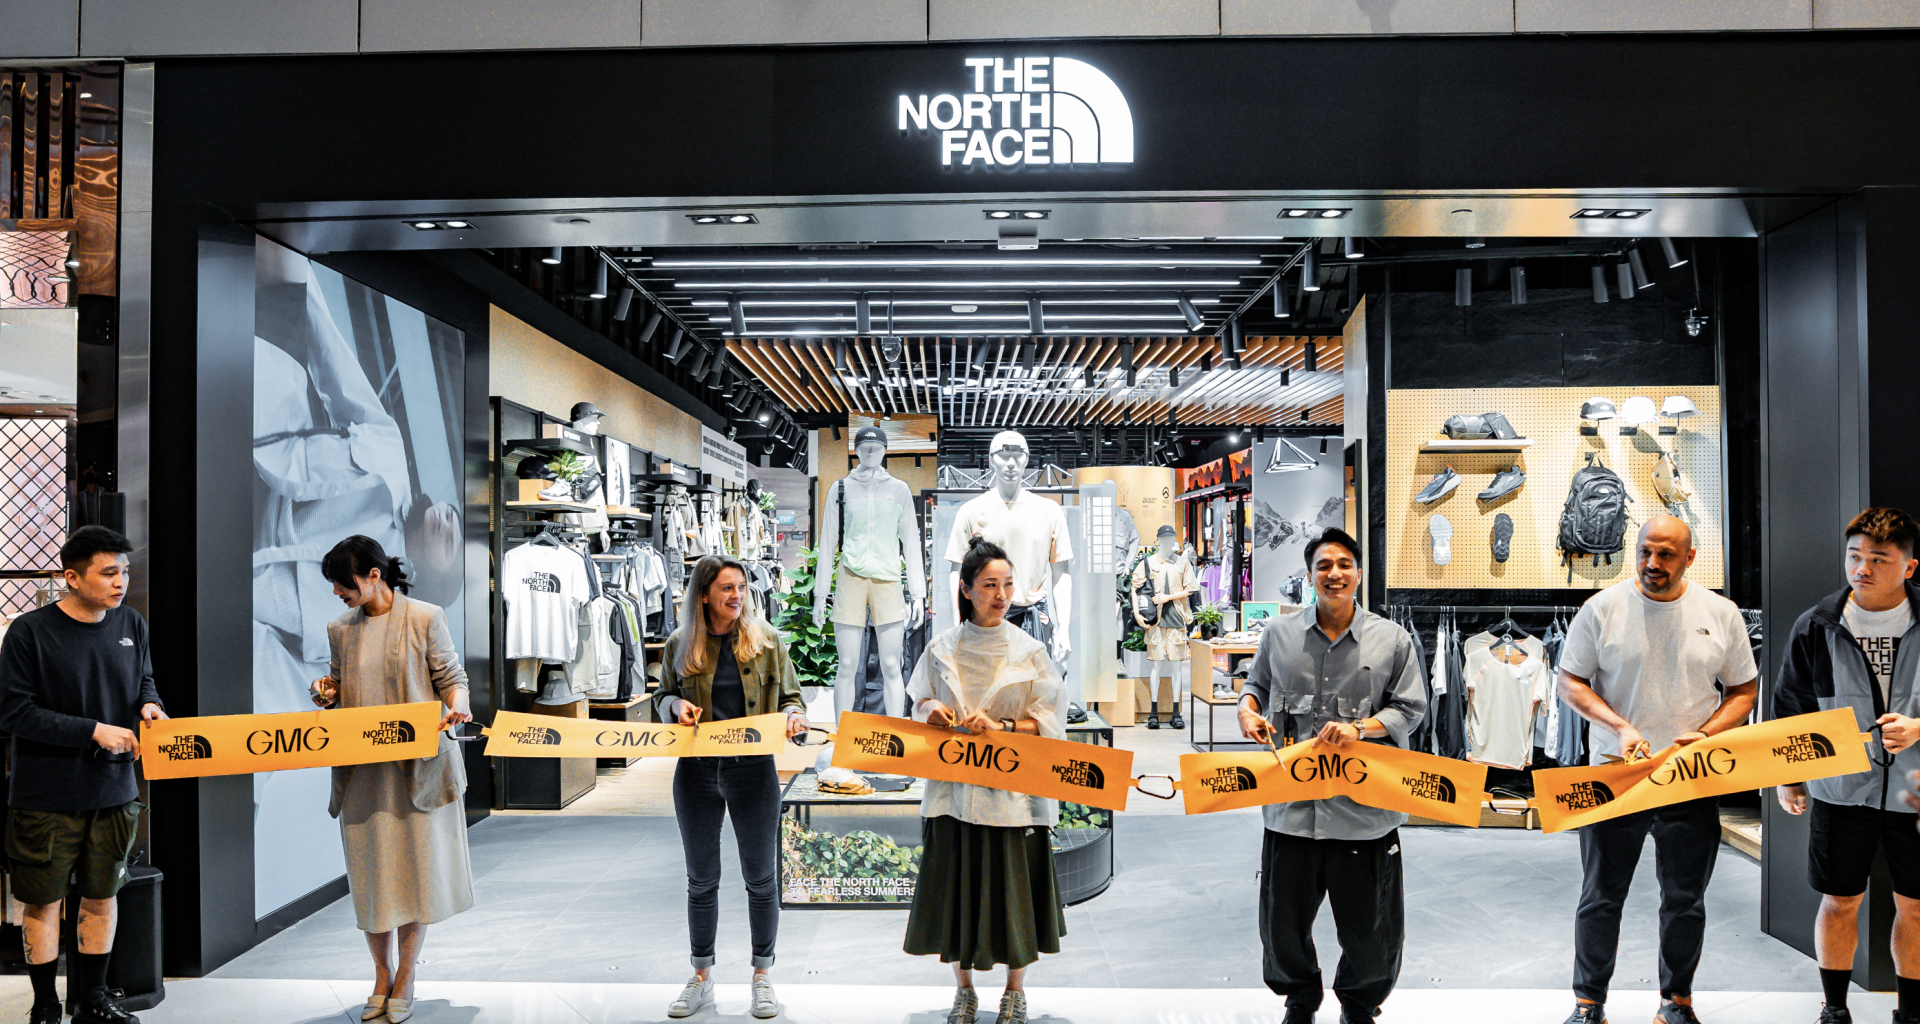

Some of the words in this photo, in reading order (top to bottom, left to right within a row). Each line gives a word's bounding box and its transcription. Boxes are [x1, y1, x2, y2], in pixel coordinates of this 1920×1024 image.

[965, 57, 1050, 92] THE
[898, 93, 1050, 130] NORTH
[942, 129, 1050, 165] FACE
[1856, 637, 1890, 649] THE
[378, 720, 398, 730] THE
[527, 726, 546, 734] THE
[174, 735, 193, 744] THE
[362, 729, 398, 739] NORTH
[509, 731, 544, 740] NORTH
[595, 730, 677, 747] GMG
[870, 731, 890, 741] THE
[1787, 733, 1809, 745] THE
[246, 726, 330, 756] GMG
[372, 736, 398, 746] FACE
[854, 736, 889, 749] NORTH
[158, 743, 193, 754] NORTH
[862, 746, 886, 756] FACE
[1772, 742, 1812, 757] NORTH
[168, 752, 194, 761] FACE
[938, 739, 1020, 773] GMG
[1786, 751, 1815, 764] FACE
[1068, 759, 1088, 770] THE
[1290, 753, 1368, 784] GMG
[1648, 747, 1736, 786] GMG
[1052, 765, 1088, 779] NORTH
[1215, 766, 1235, 776] THE
[1419, 771, 1439, 783] THE
[1060, 774, 1086, 787] FACE
[1201, 774, 1238, 787] NORTH
[1402, 776, 1439, 791] NORTH
[1570, 781, 1592, 791] THE
[1212, 782, 1238, 794] FACE
[1410, 788, 1437, 800] FACE
[1556, 789, 1593, 804] NORTH
[1568, 800, 1596, 811] FACE
[790, 878, 817, 886] FACE
[819, 878, 840, 886] THE
[843, 878, 880, 886] NORTH
[882, 878, 910, 886] FACE
[790, 887, 805, 896] TO
[808, 887, 861, 896] FEARLESS
[864, 887, 915, 896] SUMMERS
